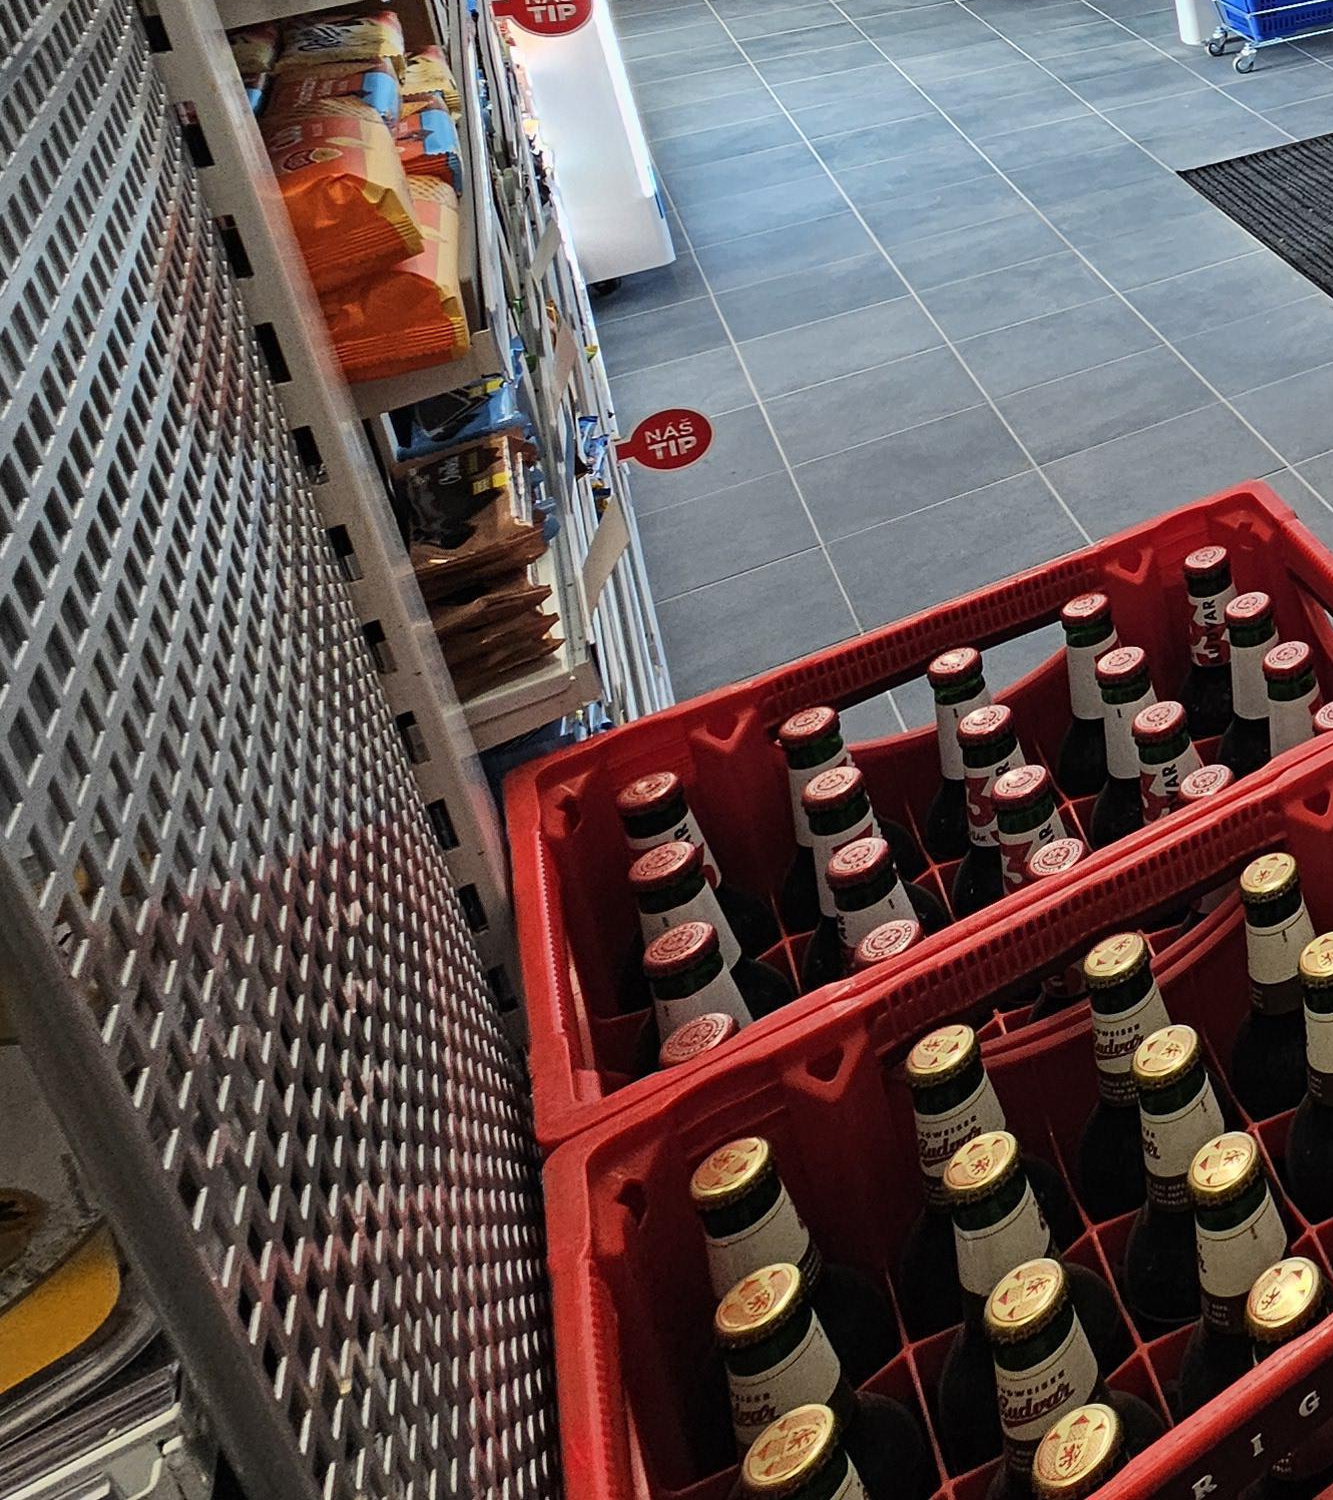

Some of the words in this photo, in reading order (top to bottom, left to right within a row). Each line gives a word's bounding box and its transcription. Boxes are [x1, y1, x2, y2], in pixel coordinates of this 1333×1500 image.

[526, 4, 577, 23] TIP
[644, 418, 694, 441] NÁŠ
[647, 438, 697, 460] TIP
